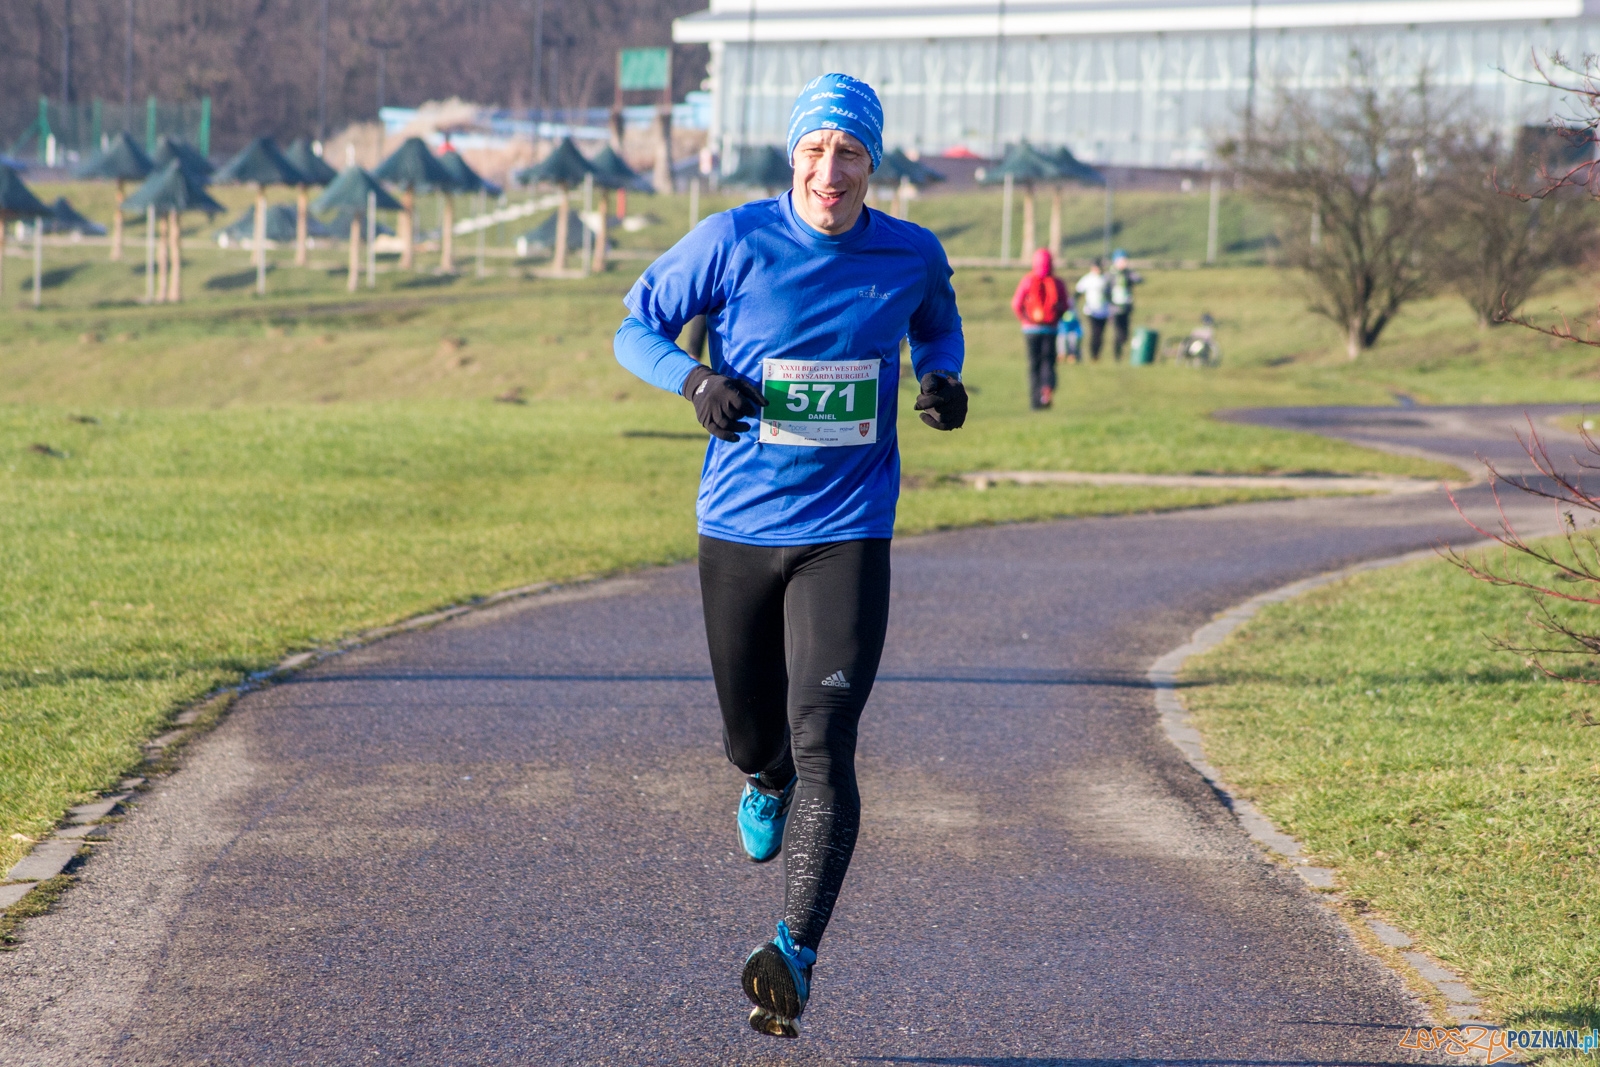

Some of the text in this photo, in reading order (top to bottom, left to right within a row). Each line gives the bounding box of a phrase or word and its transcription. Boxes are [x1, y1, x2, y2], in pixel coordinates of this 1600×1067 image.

[820, 363, 873, 372] SYLWESTROWY
[835, 372, 870, 380] BURGIELA
[786, 383, 856, 413] 571
[821, 680, 851, 688] adidas
